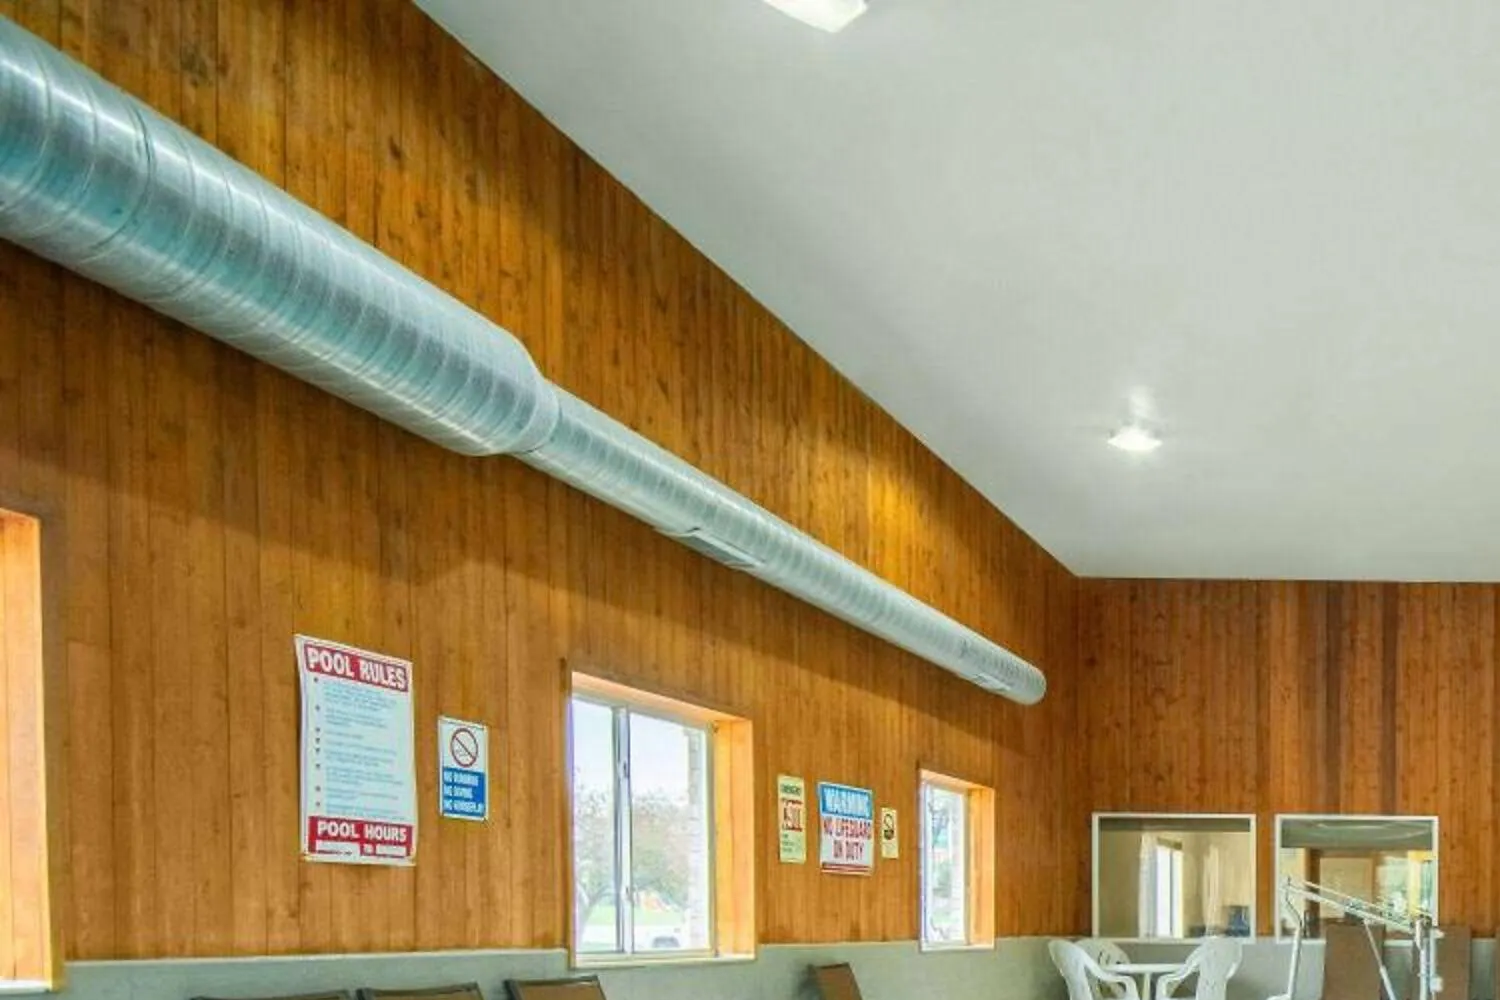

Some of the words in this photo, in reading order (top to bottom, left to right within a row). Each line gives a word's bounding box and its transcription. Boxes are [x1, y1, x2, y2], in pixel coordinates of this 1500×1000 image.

[306, 645, 355, 678] POOL
[359, 660, 405, 689] RULES
[824, 787, 870, 818] WARNING
[316, 821, 360, 839] POOL
[364, 824, 408, 842] HOURS
[824, 817, 833, 836] NO
[835, 818, 871, 840] LIFEGUARD
[833, 839, 843, 858] ON
[845, 841, 864, 860] DUTY
